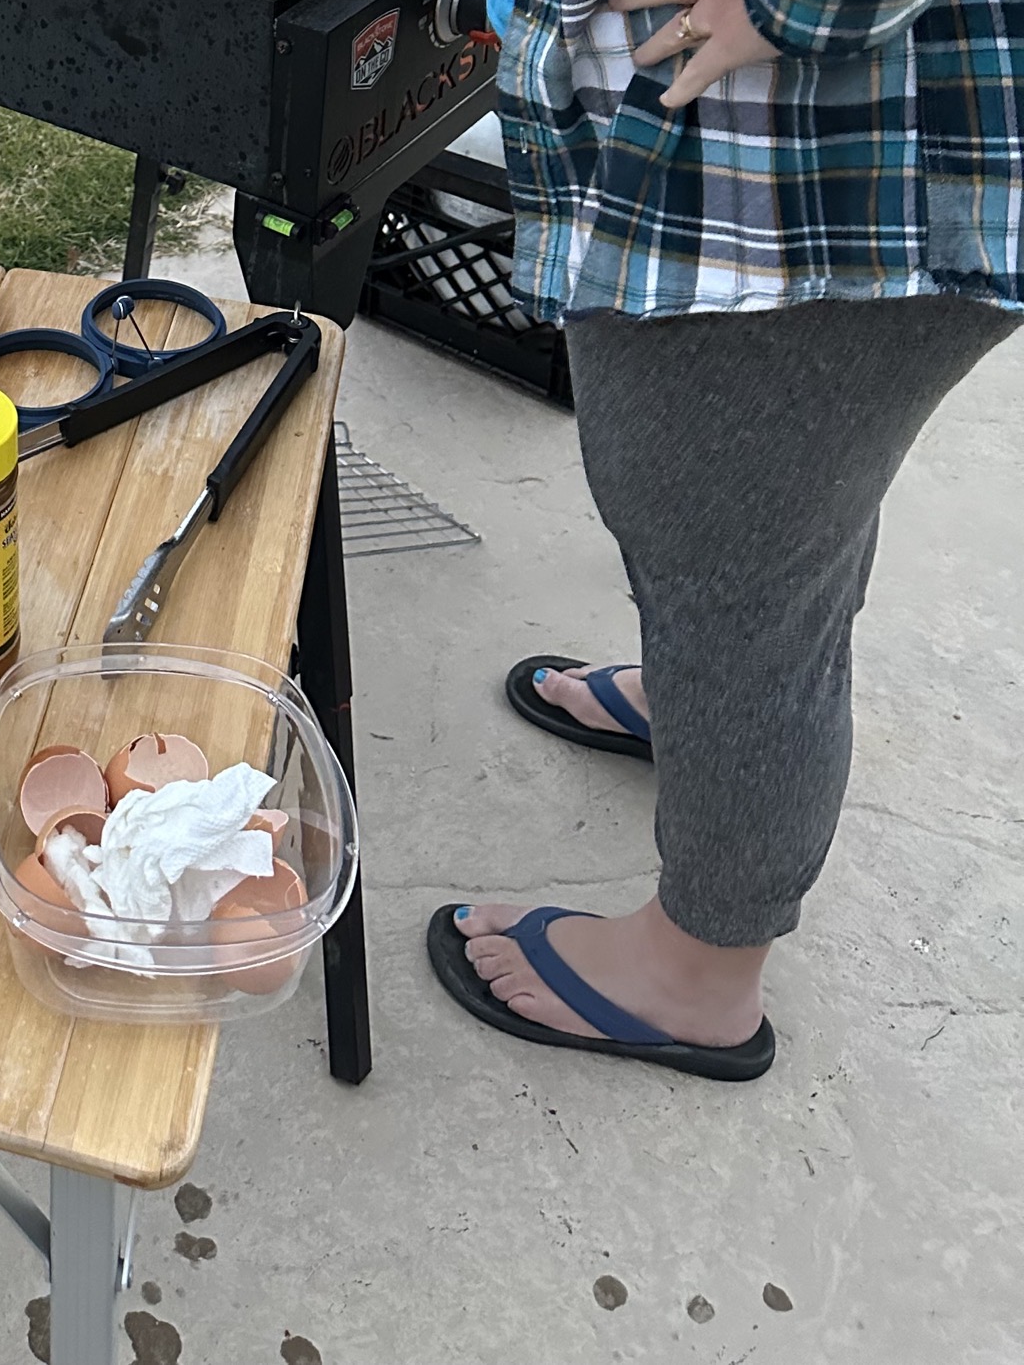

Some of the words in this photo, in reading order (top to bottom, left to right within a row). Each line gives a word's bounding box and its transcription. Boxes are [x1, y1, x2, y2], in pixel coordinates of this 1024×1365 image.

[356, 65, 367, 84] ON
[367, 55, 380, 73] THE
[380, 48, 390, 65] GO
